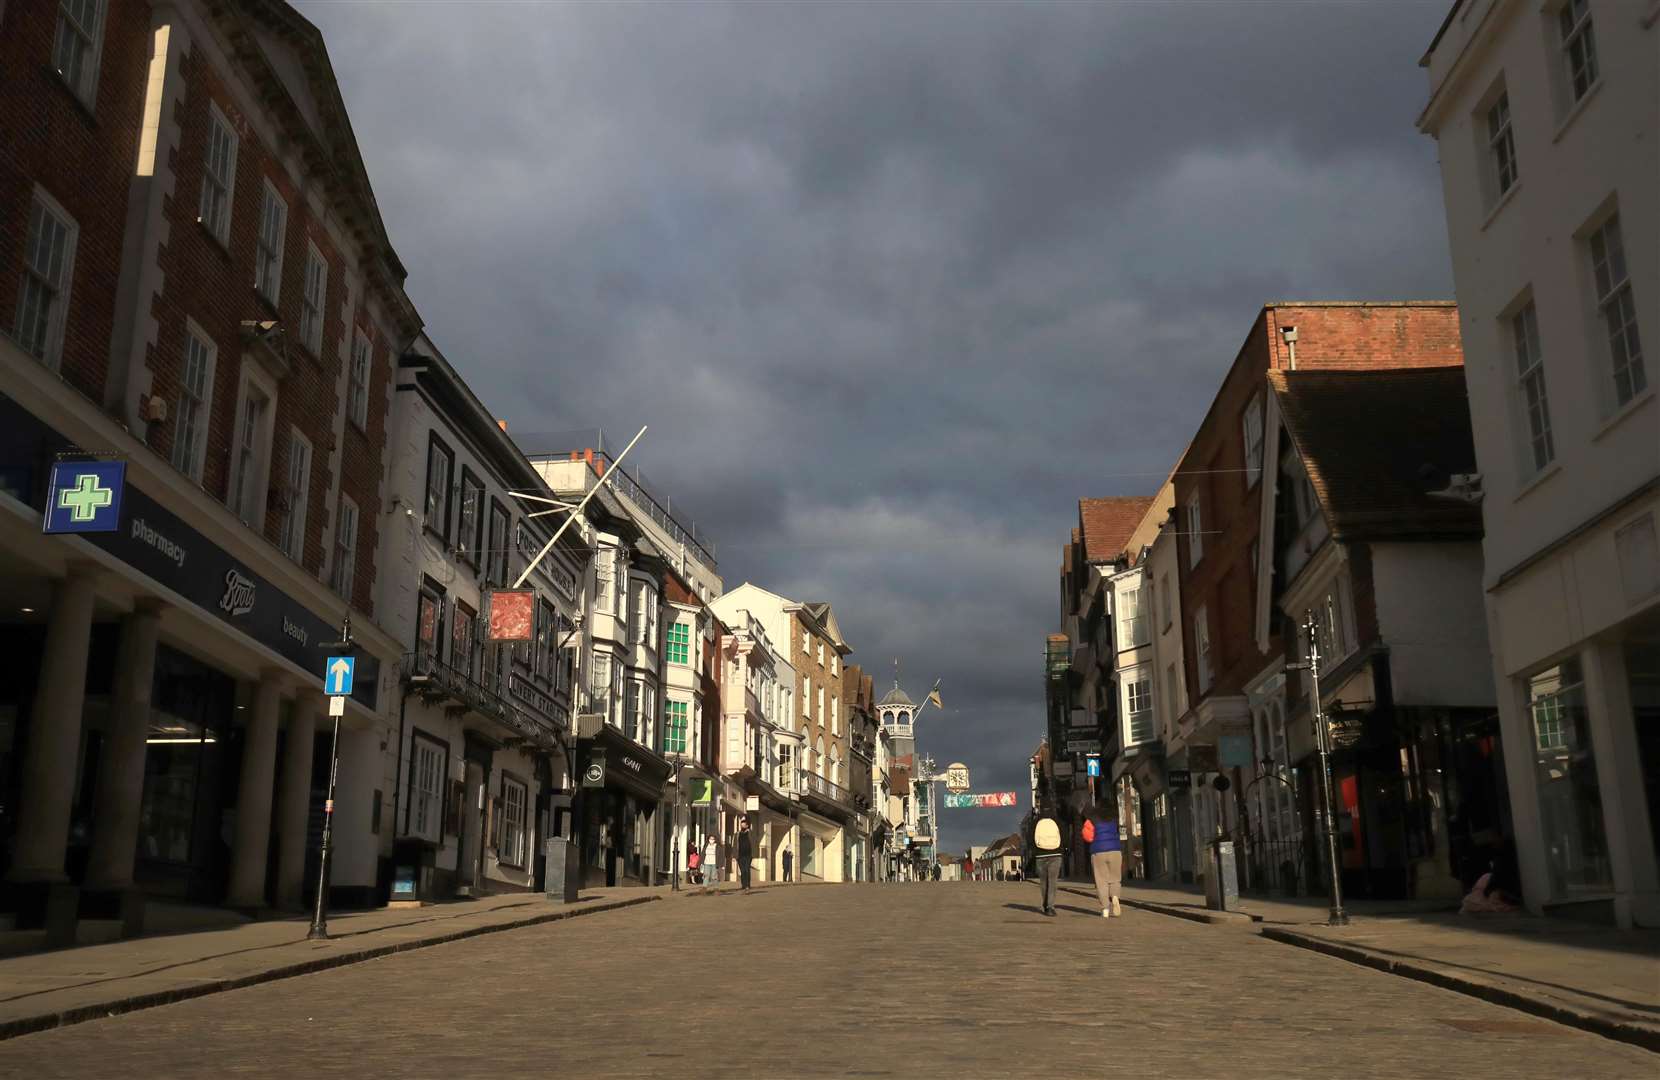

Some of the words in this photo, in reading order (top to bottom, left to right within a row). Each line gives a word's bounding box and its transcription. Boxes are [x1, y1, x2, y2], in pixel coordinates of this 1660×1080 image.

[131, 518, 186, 568] pharmacy
[219, 568, 256, 616] Boots
[283, 615, 309, 647] beauty
[512, 678, 536, 704] LIVERY
